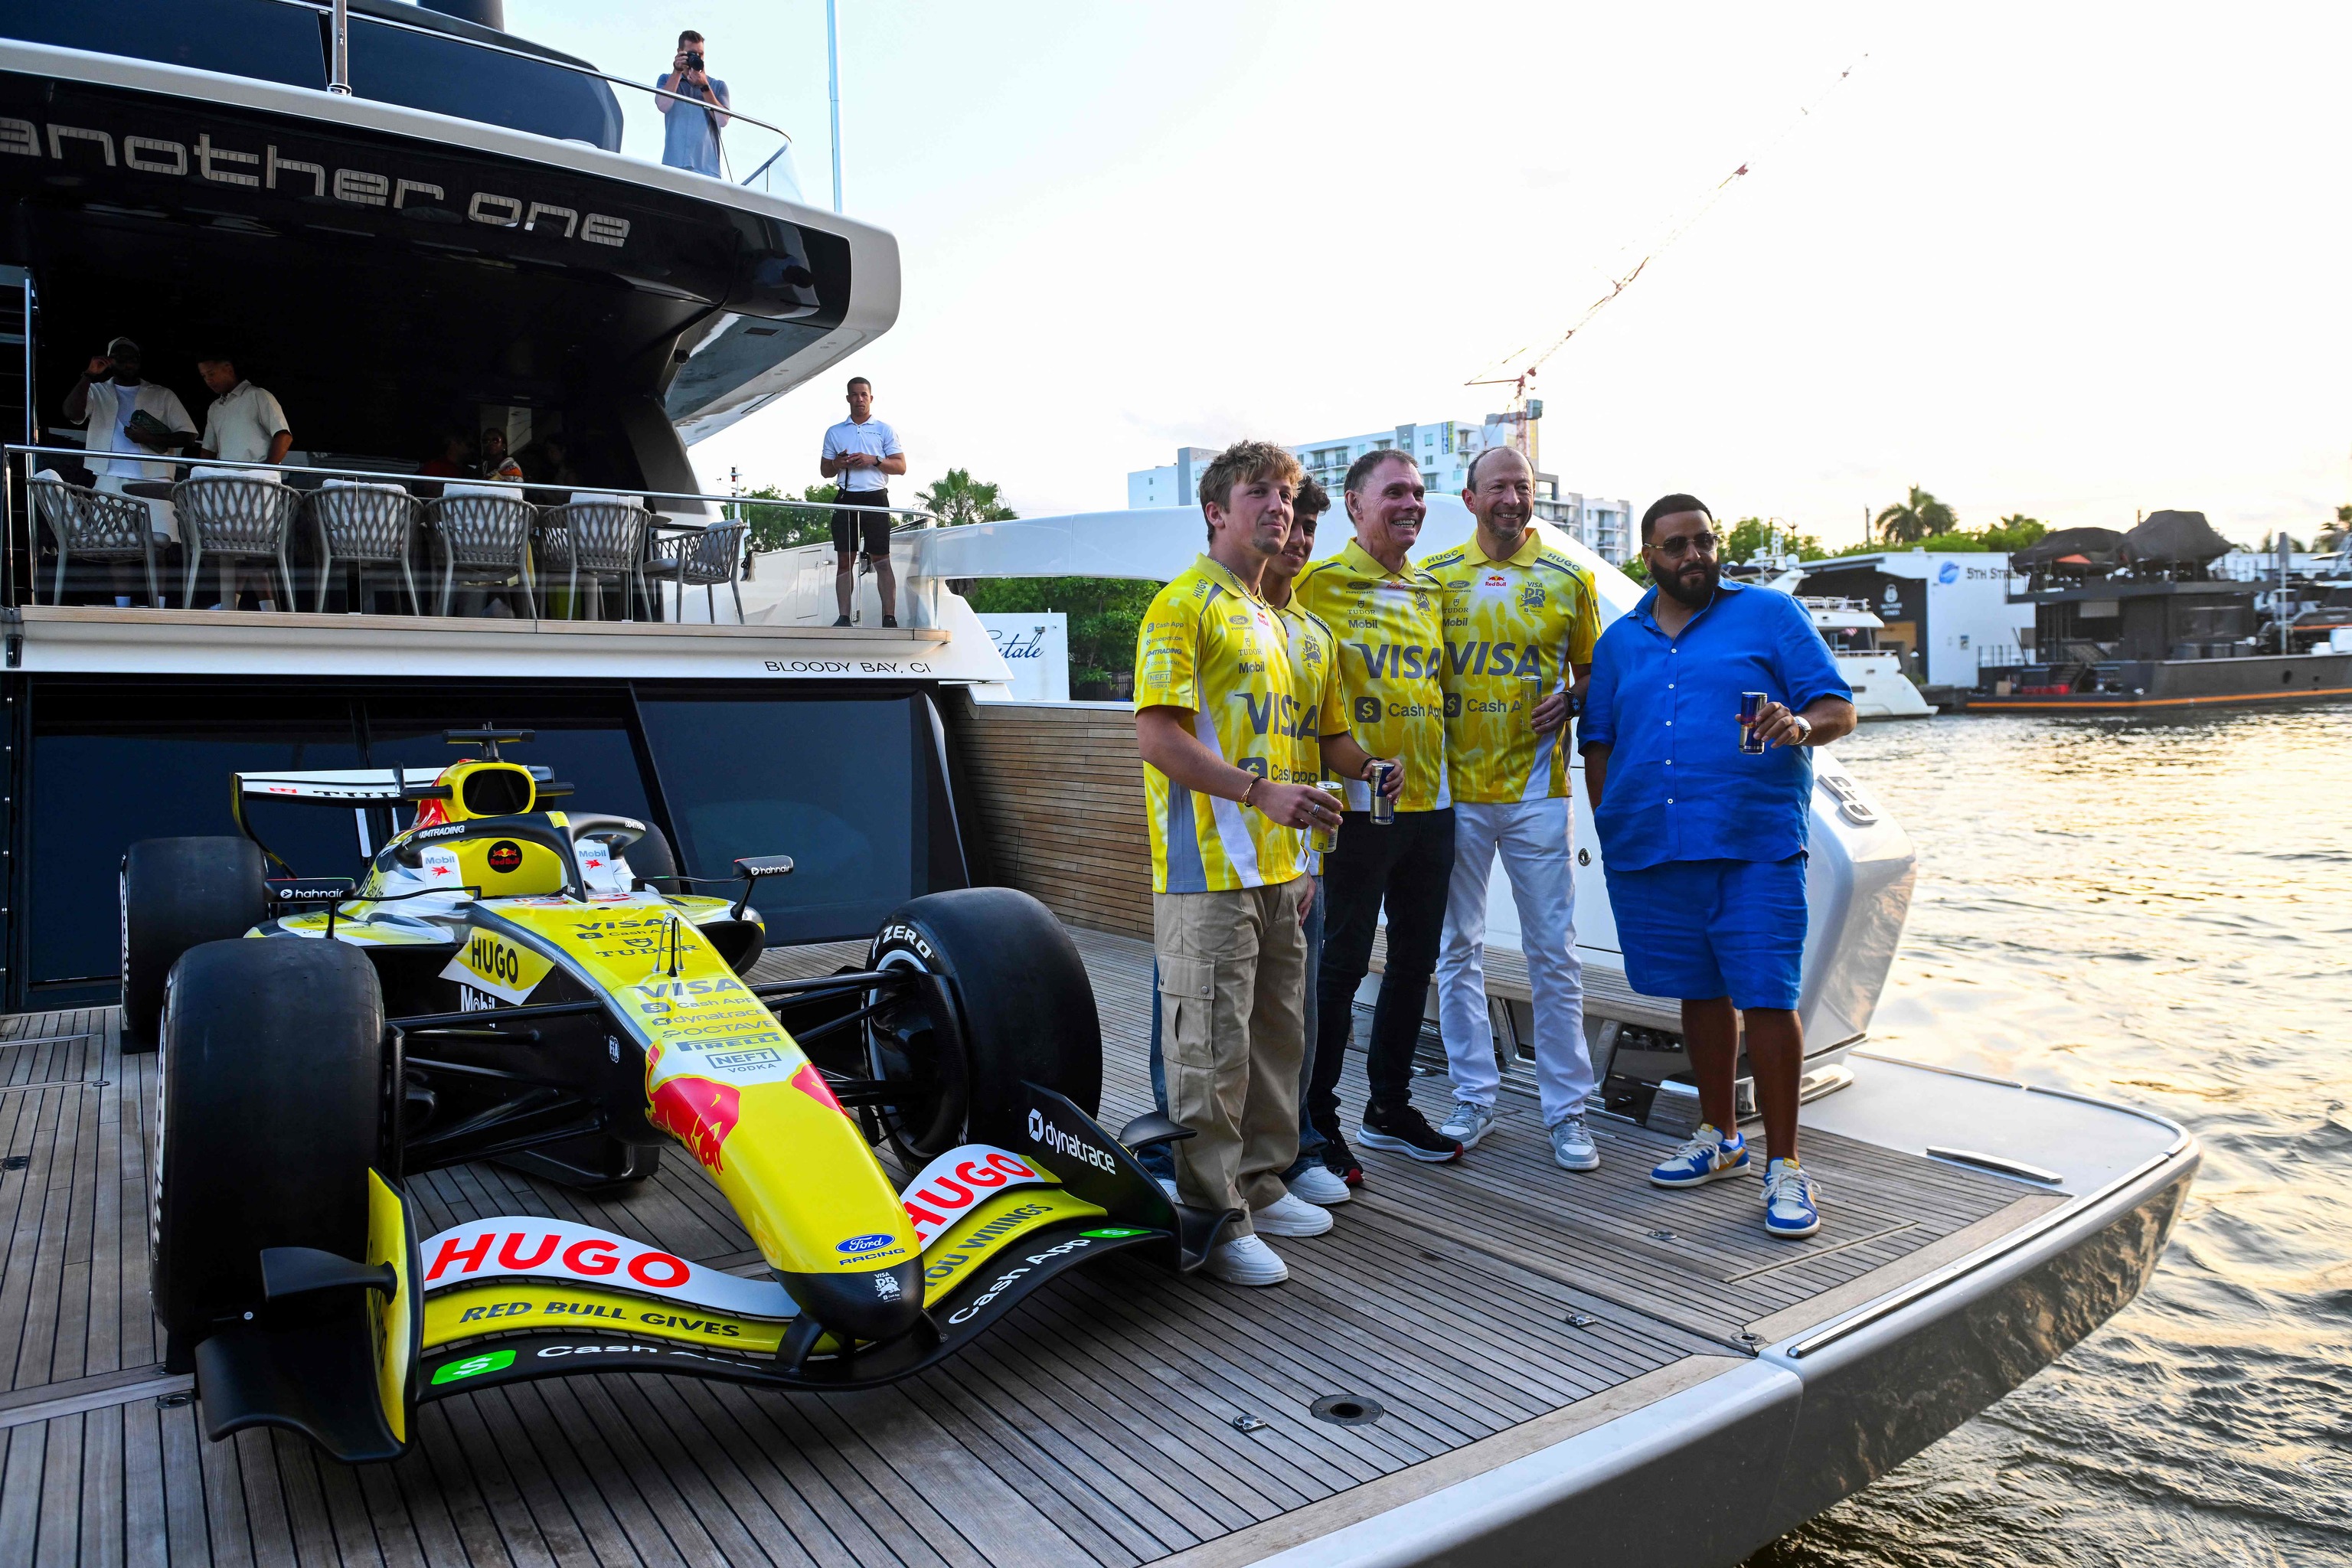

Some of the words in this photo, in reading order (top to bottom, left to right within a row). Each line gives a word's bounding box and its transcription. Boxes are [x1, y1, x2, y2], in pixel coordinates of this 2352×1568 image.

[0, 118, 444, 208] another
[468, 191, 630, 247] one
[1427, 550, 1459, 564] HUGO
[1547, 553, 1582, 573] HUGO
[1966, 567, 1987, 579] 5TH
[1192, 579, 1208, 599] HUGO
[1348, 619, 1378, 629] Mobil
[1443, 617, 1468, 627] Mobil
[1304, 632, 1318, 642] VISA
[1350, 643, 1442, 681] VISA
[1444, 641, 1544, 677] VISA
[764, 661, 851, 672] BLOODY
[860, 662, 903, 675] BAY,
[910, 662, 932, 673] CI
[1238, 661, 1265, 674] Mobil
[1388, 702, 1426, 717] Cash
[1467, 698, 1506, 713] Cash
[419, 825, 466, 839] XMTRADING
[425, 856, 456, 865] Mobil
[760, 864, 790, 874] hahnair
[295, 888, 344, 899] hahnair
[564, 918, 671, 930] VISA
[873, 936, 880, 960] P
[882, 925, 932, 959] ZERO
[596, 944, 701, 958] TUDOR
[472, 935, 518, 985] HUGO
[626, 978, 746, 998] VISA
[677, 999, 719, 1009] Cash
[723, 997, 756, 1006] App
[673, 1008, 768, 1024] dynatrace
[683, 1020, 778, 1036] OCTAVE
[675, 1031, 782, 1052] PIRELLI
[714, 1050, 769, 1066] NEFT
[727, 1063, 777, 1073] VODKA
[1045, 1121, 1116, 1176] dynatrace
[903, 1152, 1036, 1243] HUGO
[848, 1236, 884, 1251] Ford
[425, 1233, 691, 1288] HUGO
[839, 1248, 906, 1266] RACING
[948, 1267, 1031, 1325] Cash
[1025, 1239, 1091, 1265] App
[459, 1302, 533, 1324] RED
[544, 1302, 627, 1320] BULL
[640, 1312, 740, 1338] GIVES
[537, 1344, 658, 1358] Cash
